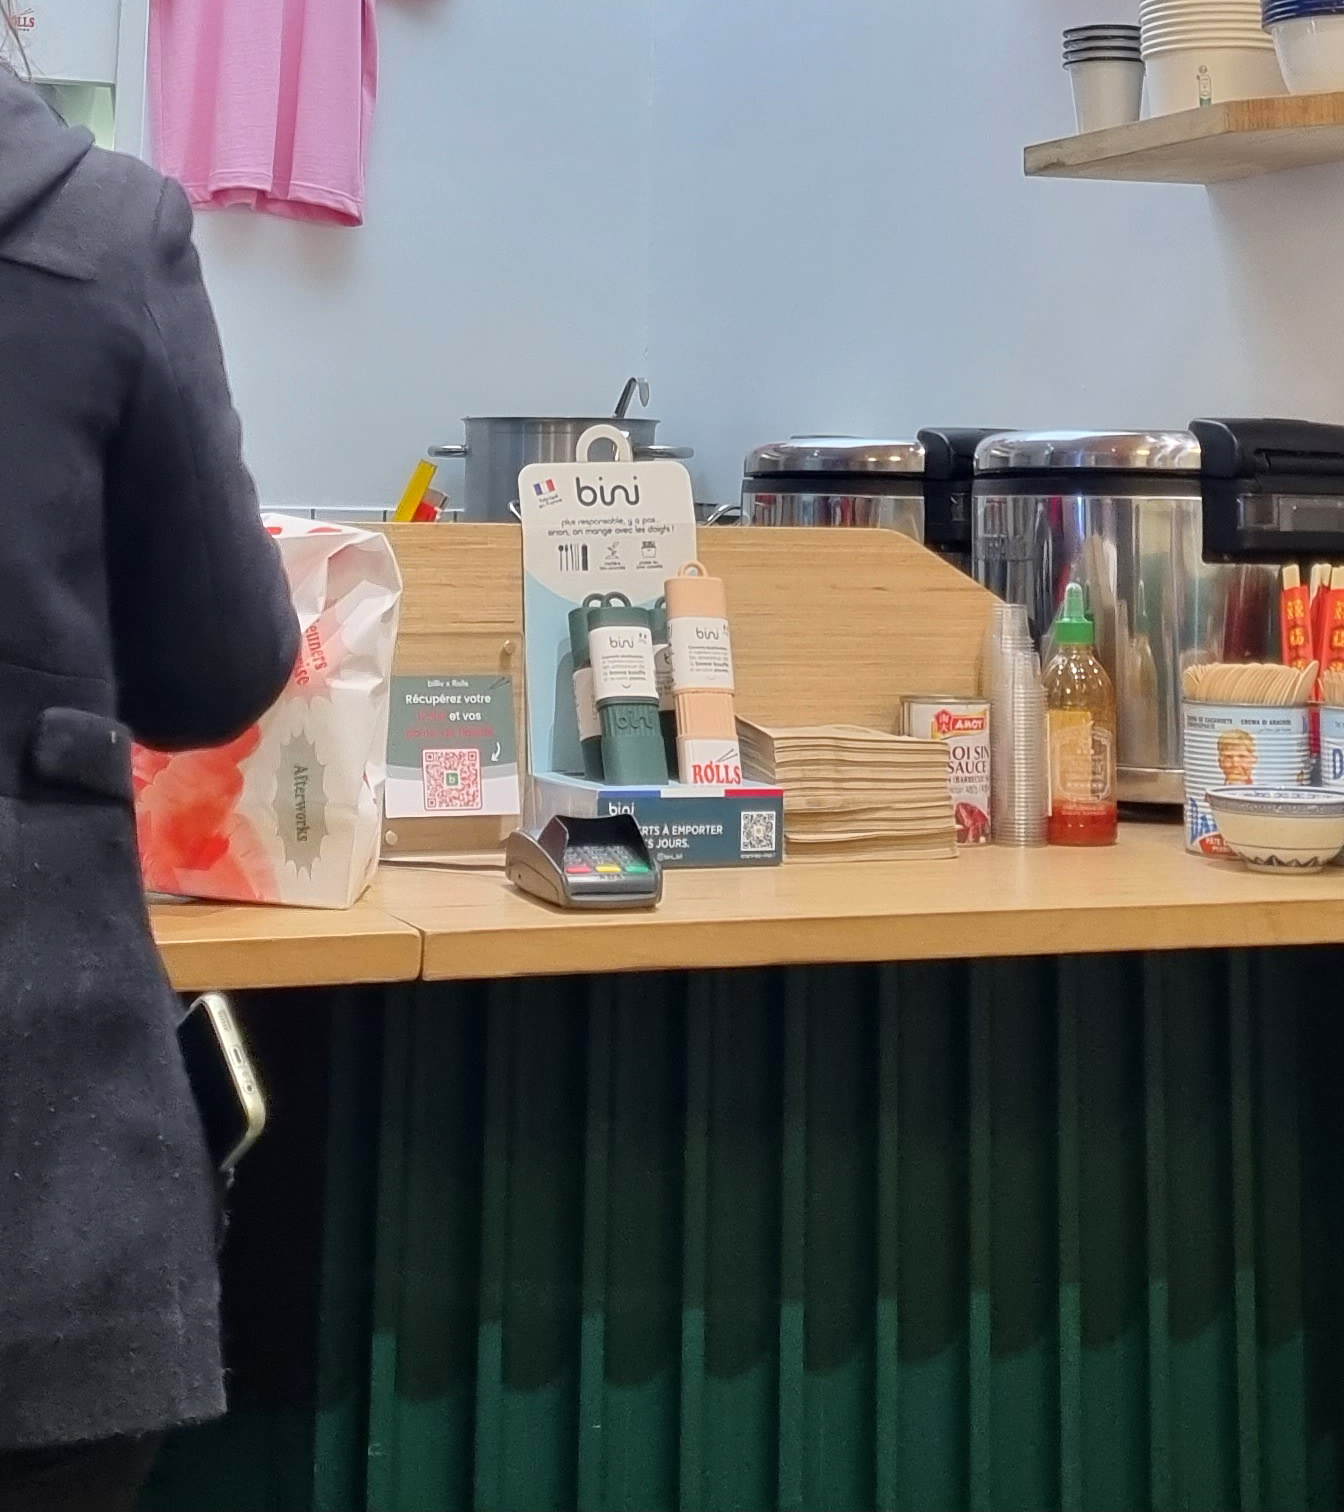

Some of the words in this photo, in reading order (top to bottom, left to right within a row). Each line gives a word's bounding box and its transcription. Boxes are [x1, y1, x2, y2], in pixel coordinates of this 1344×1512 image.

[575, 475, 640, 507] bini
[696, 627, 719, 640] bini
[405, 693, 462, 707] Récupérez
[464, 694, 491, 704] votre
[449, 711, 461, 721] et
[462, 712, 481, 721] vos
[948, 760, 987, 774] SAUCE
[293, 764, 310, 842] Afterworks
[672, 825, 723, 835] EMPORTER
